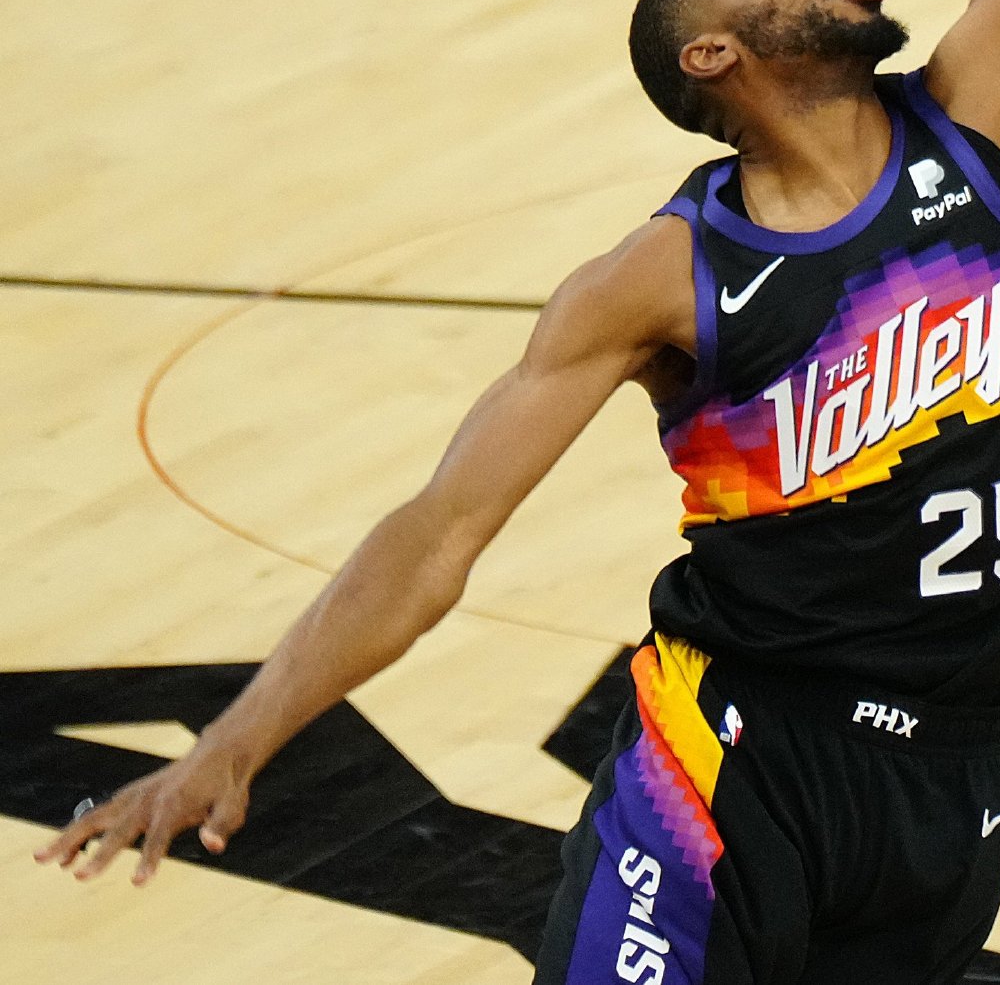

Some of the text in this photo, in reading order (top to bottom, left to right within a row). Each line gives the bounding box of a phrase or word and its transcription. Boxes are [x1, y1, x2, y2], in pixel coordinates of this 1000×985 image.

[911, 185, 972, 226] PayPal
[825, 345, 868, 390] THE
[852, 701, 919, 738] PHX
